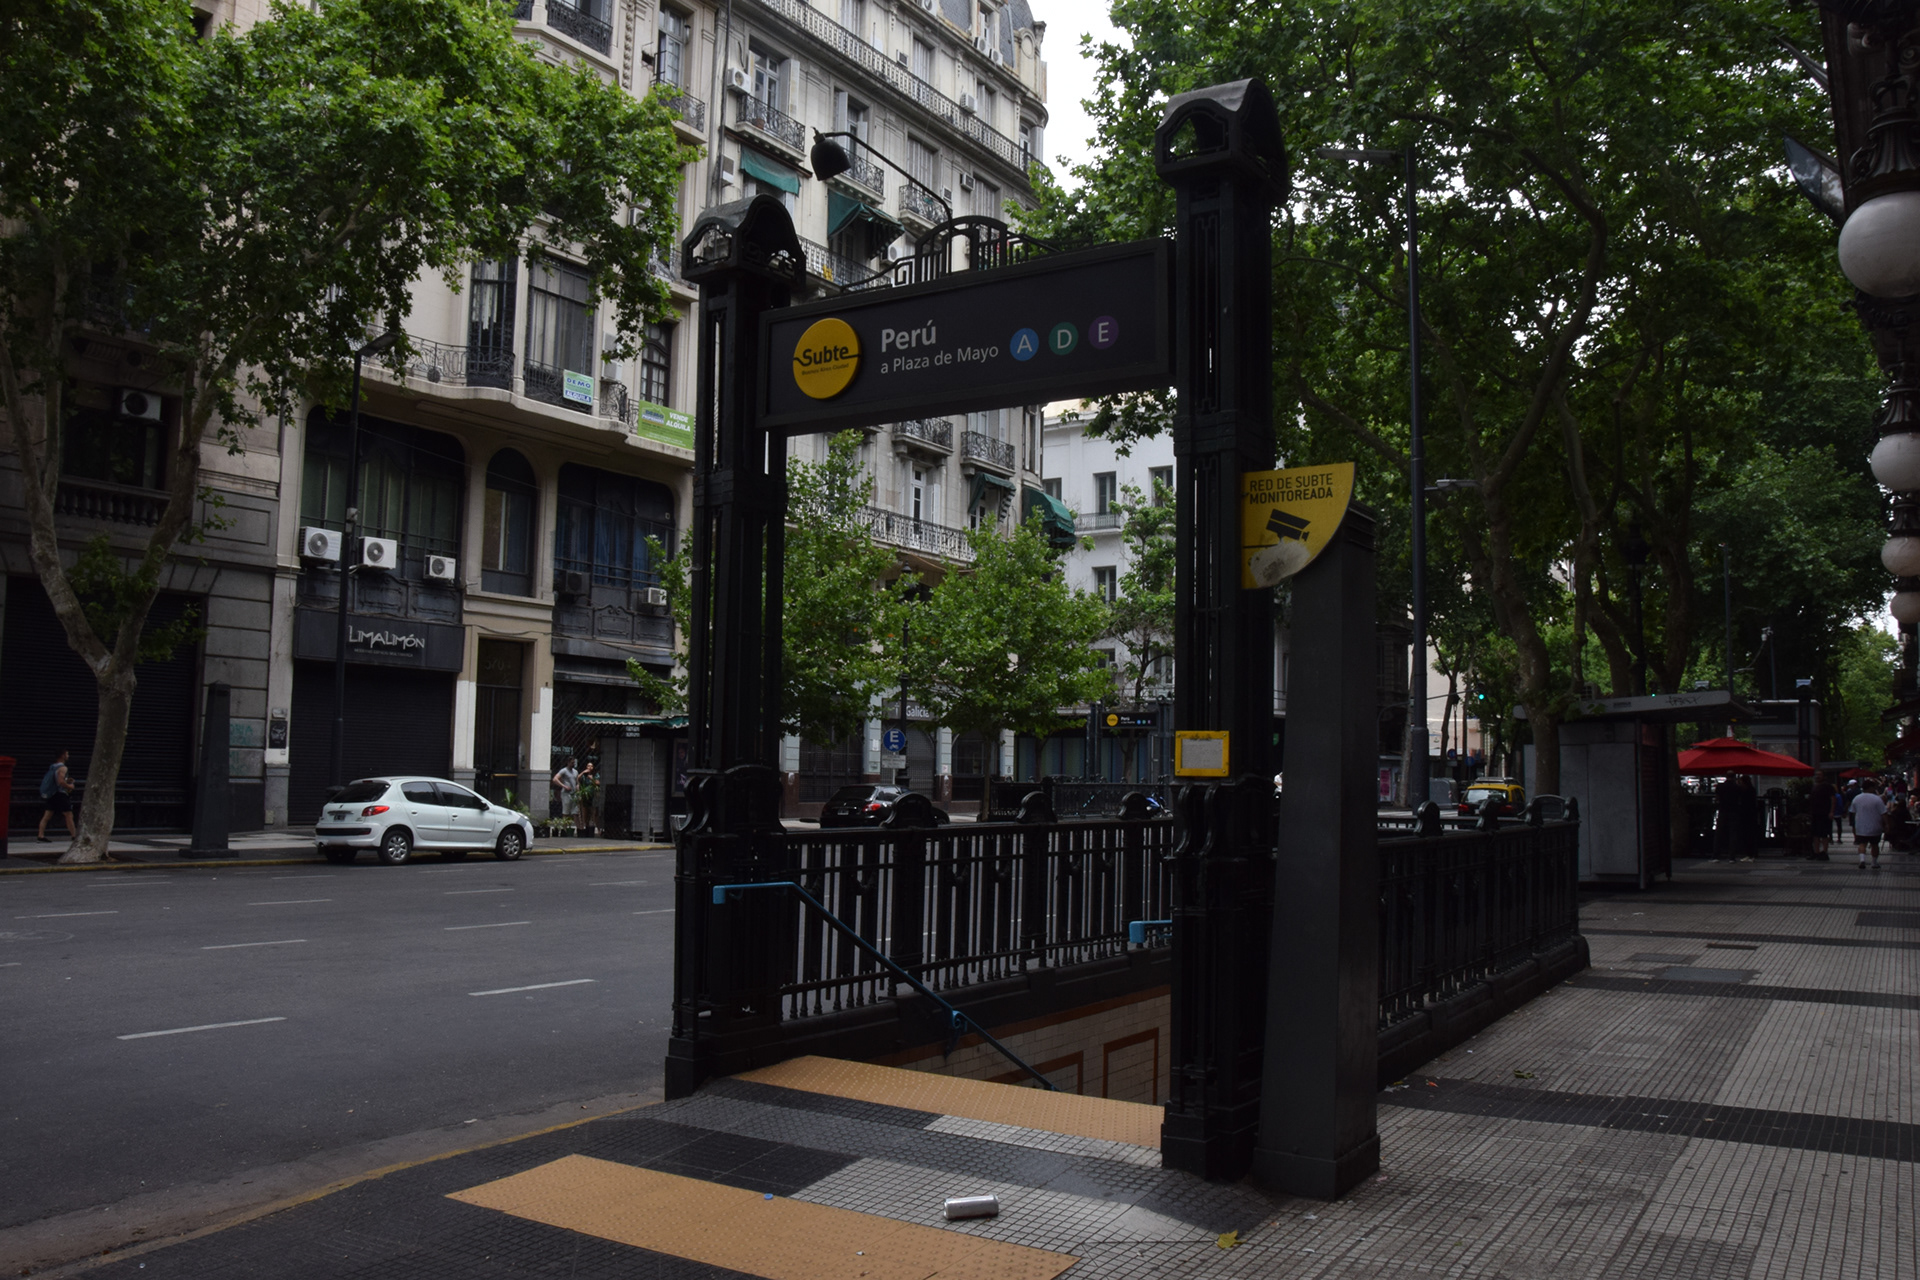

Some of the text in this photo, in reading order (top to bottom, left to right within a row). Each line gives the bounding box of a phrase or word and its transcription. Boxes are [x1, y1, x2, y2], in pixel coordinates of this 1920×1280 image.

[881, 319, 937, 353] Perú
[1016, 322, 1110, 354] A D E
[796, 345, 857, 366] Subte
[880, 346, 999, 374] a Plaza de Mayo
[566, 377, 591, 389] DEMO
[669, 411, 689, 423] VENDE
[666, 420, 691, 432] ALQUILA
[1249, 473, 1333, 492] RED DE SUBTE
[1249, 487, 1333, 504] MONITOREADA
[906, 705, 930, 718] Galicia
[889, 730, 900, 743] E
